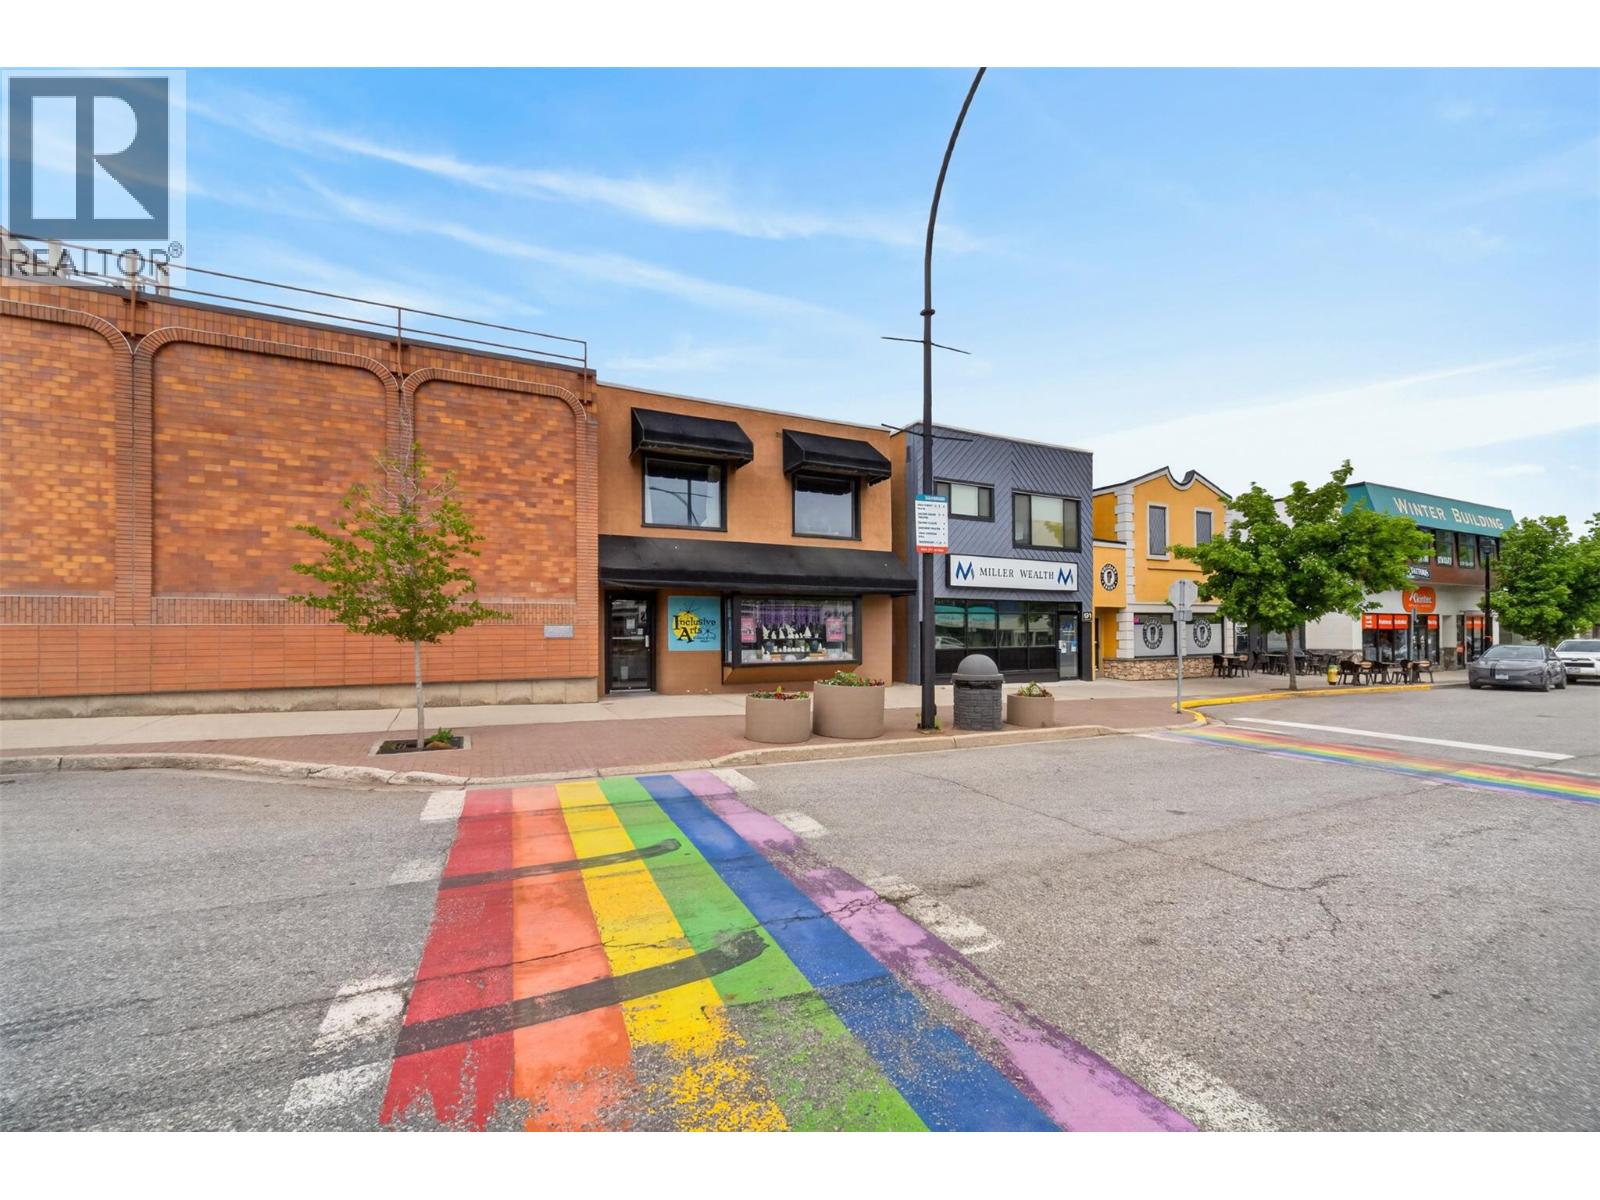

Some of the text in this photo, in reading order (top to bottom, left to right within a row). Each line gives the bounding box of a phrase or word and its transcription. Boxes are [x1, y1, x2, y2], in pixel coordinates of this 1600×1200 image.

[1393, 497, 1504, 529] WINTER BUILDING
[979, 566, 1015, 578] MILLER
[1019, 568, 1055, 580] WEALTH
[672, 615, 717, 630] Inclusive
[676, 627, 702, 643] Arts
